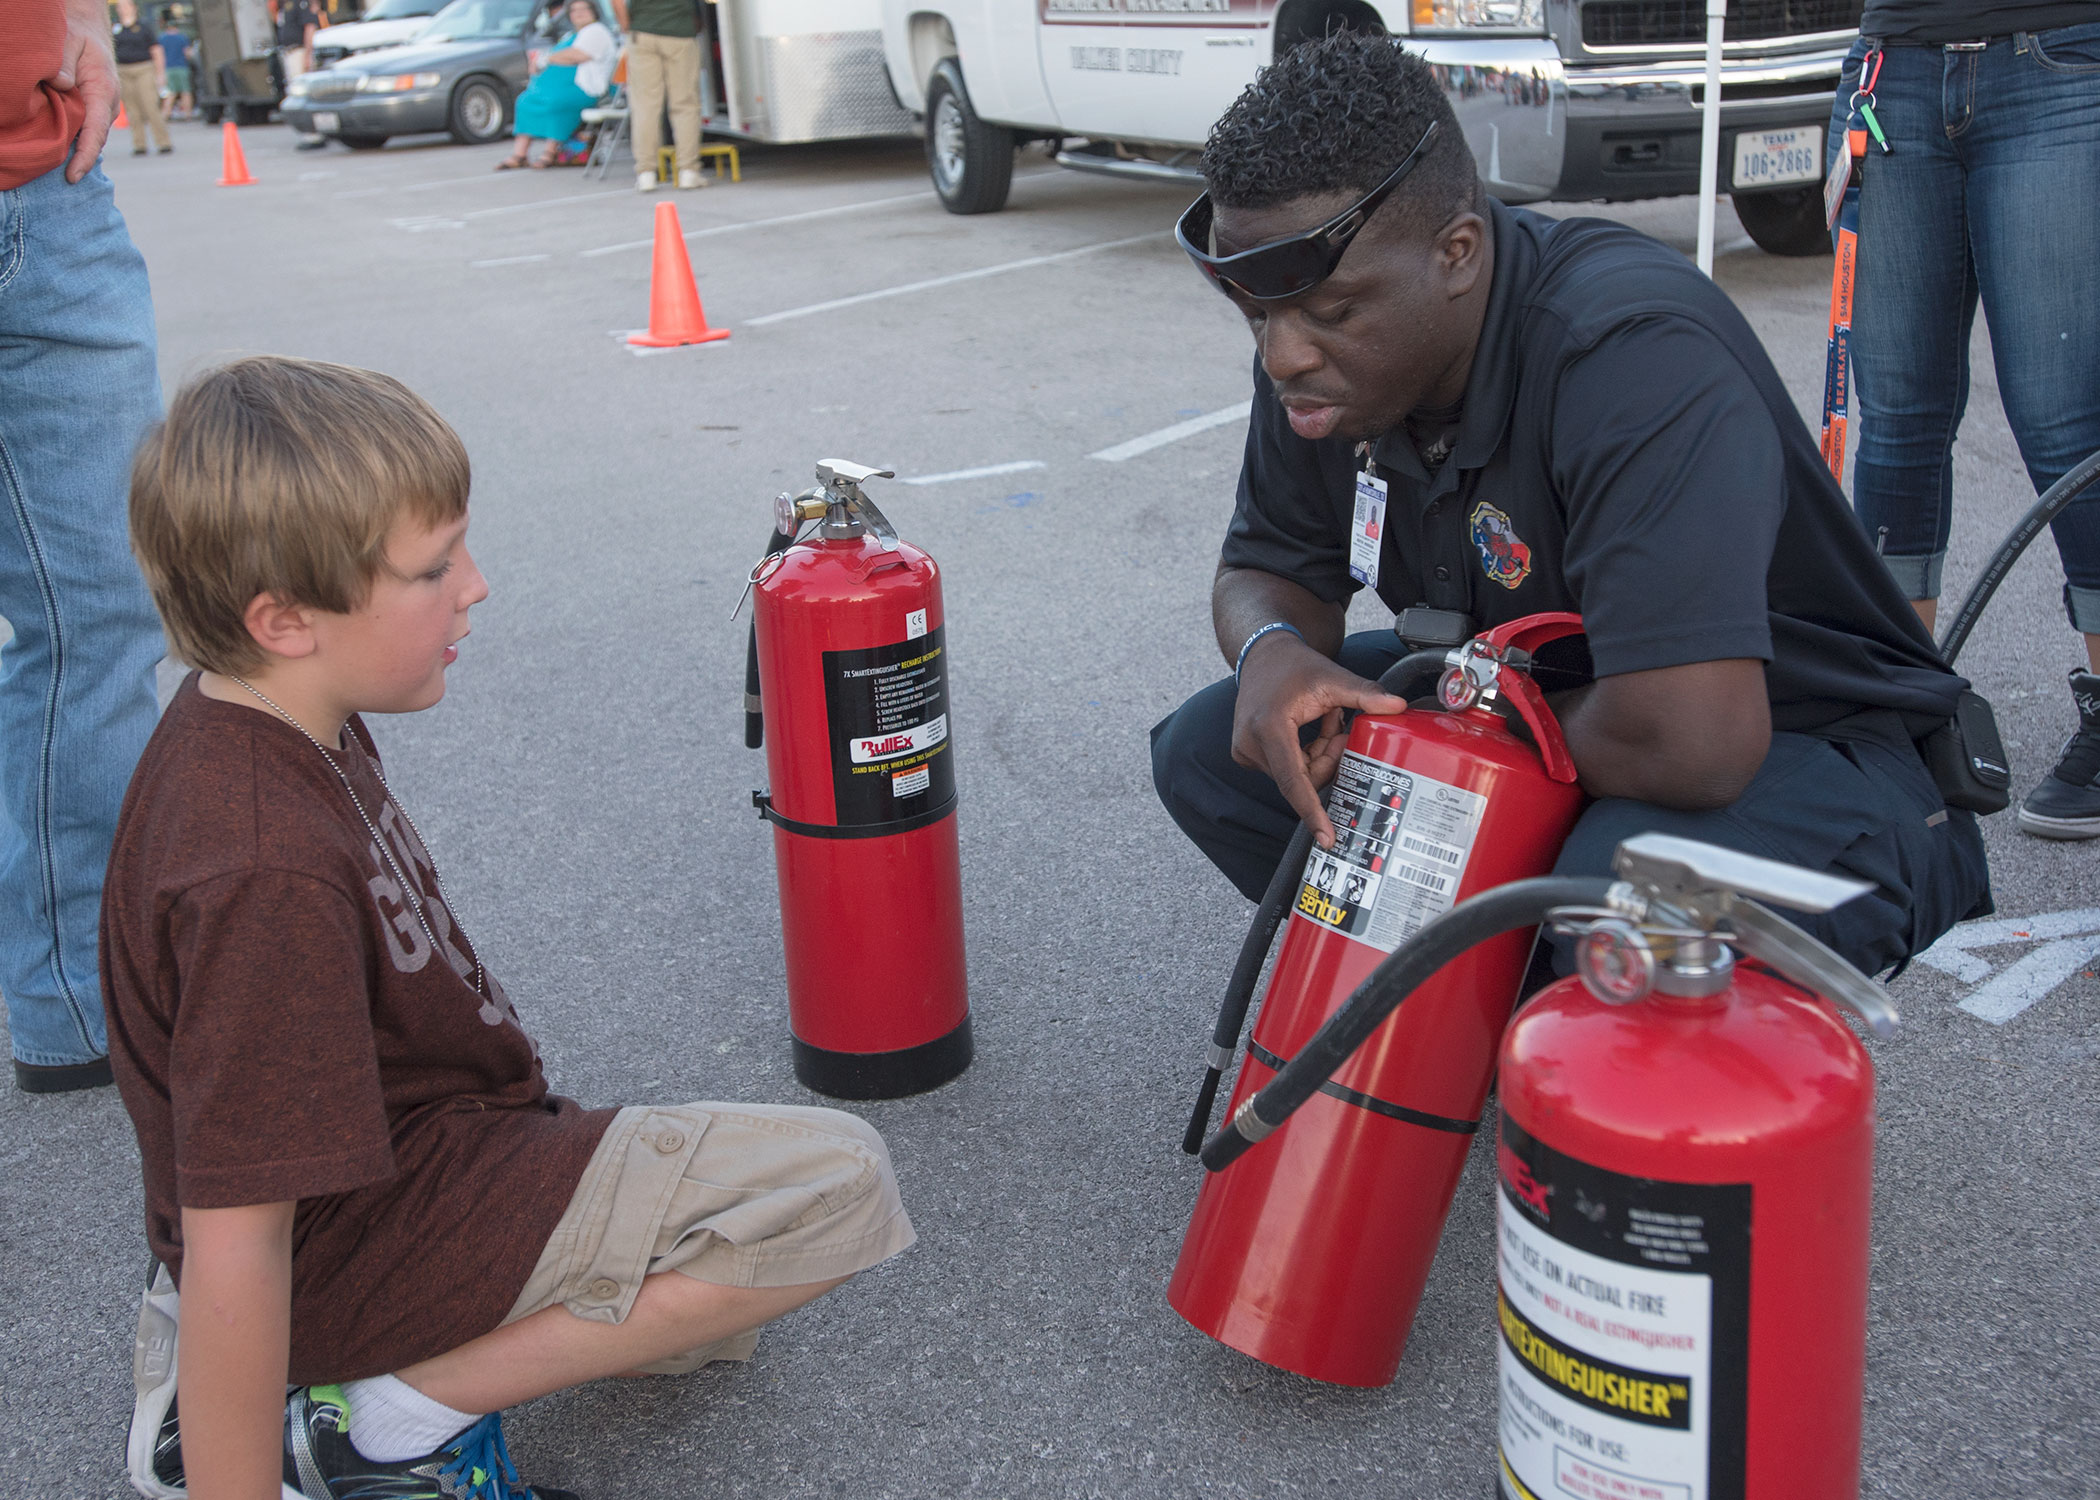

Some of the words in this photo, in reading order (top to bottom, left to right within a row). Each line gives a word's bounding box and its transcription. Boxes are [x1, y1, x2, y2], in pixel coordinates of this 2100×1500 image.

[1125, 48, 1183, 75] COUNTY
[1762, 132, 1796, 146] TEXAS
[1841, 240, 1851, 293] HOUSTON
[1840, 295, 1849, 317] SAM
[1836, 335, 1847, 406] BEARKATS
[1834, 425, 1843, 476] HOUSTON
[843, 670, 852, 679] 7X
[901, 656, 922, 669] RECHARGE
[861, 735, 913, 758] BullEx
[852, 765, 868, 775] STAND
[868, 763, 880, 773] BACK
[890, 760, 904, 769] WHEN
[904, 757, 917, 766] USING
[917, 754, 925, 762] THIS
[1298, 892, 1347, 926] sentry
[1523, 1242, 1540, 1272] USE
[1544, 1257, 1564, 1285] ON
[1567, 1272, 1623, 1310] ACTUAL
[1628, 1290, 1666, 1317] FIRE
[1543, 1291, 1561, 1316] NOT
[1564, 1303, 1572, 1320] A
[1575, 1310, 1601, 1334] REAL
[1604, 1319, 1696, 1353] EXTINGUISHER
[143, 1336, 168, 1376] FILA
[1568, 1425, 1595, 1452] FOR
[1611, 1478, 1635, 1496] ONLY
